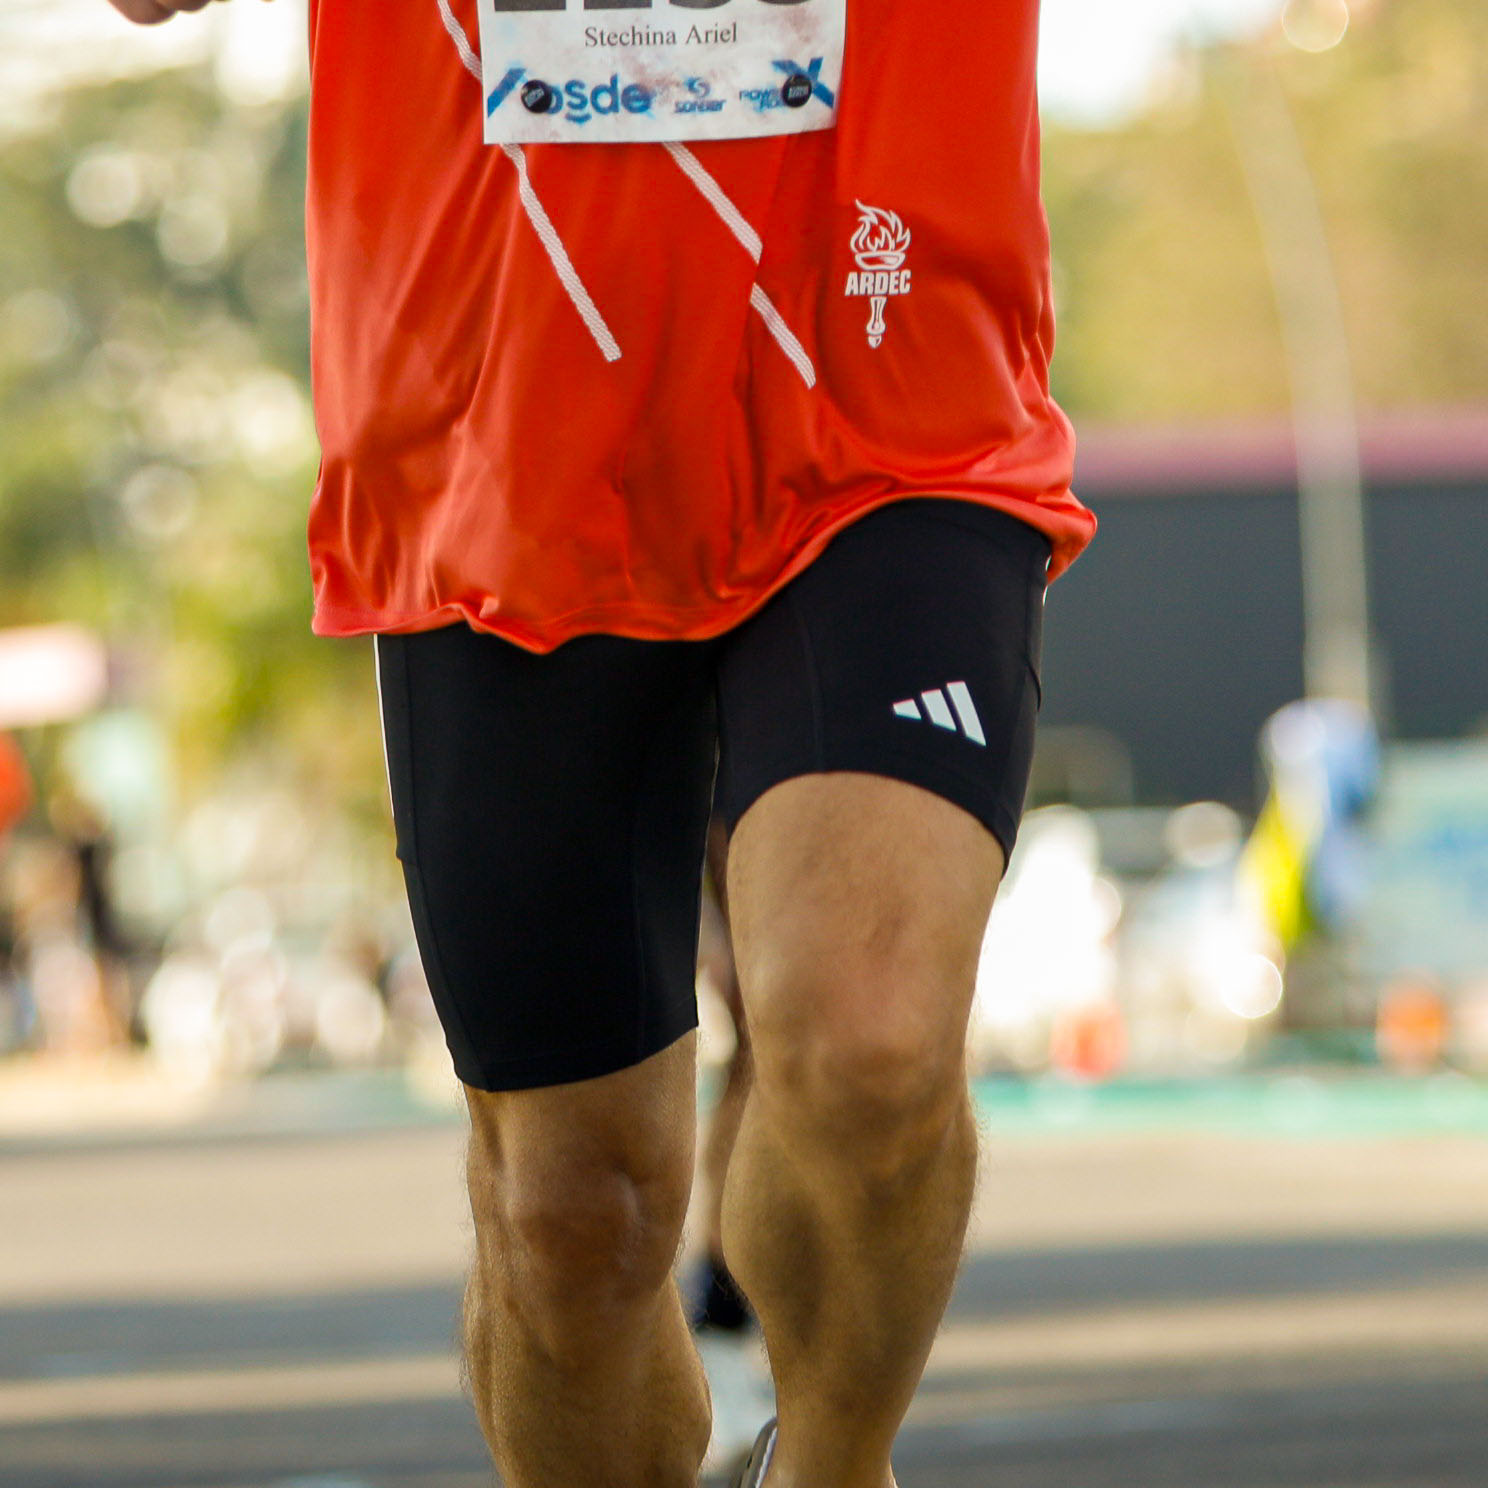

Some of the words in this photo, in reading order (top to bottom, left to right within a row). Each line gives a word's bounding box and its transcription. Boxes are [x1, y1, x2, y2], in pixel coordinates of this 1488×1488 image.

[584, 24, 677, 47] Stechina
[685, 22, 738, 44] Ariel
[844, 269, 912, 297] ARDEC
